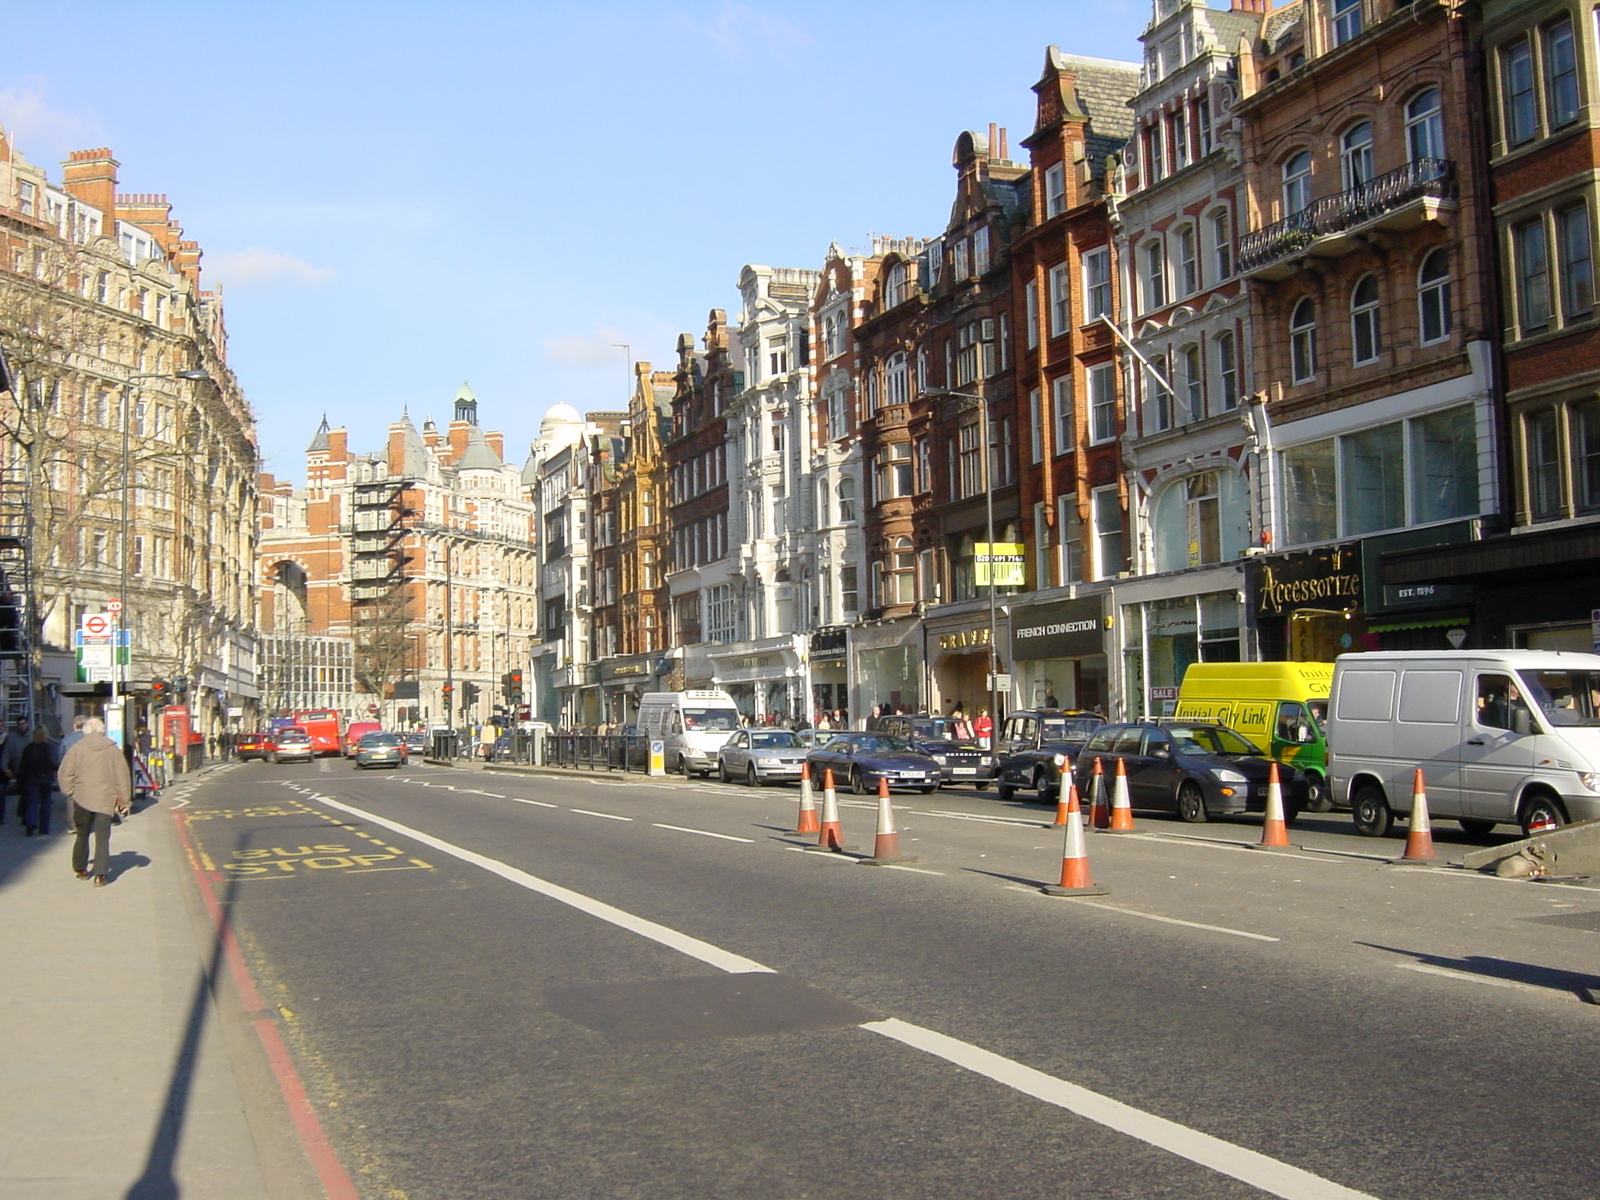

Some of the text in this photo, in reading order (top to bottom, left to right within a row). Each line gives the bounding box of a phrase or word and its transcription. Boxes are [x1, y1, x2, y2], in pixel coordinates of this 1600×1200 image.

[1259, 566, 1359, 613] Accessorize
[1417, 585, 1435, 596] 1896
[1016, 619, 1097, 639] FRENCH CONNECTION
[1152, 689, 1173, 699] SALE
[1178, 706, 1212, 724] Initial
[1217, 707, 1239, 730] City
[1242, 707, 1267, 725] Link
[230, 843, 352, 859] BUS
[222, 853, 397, 875] STOP
